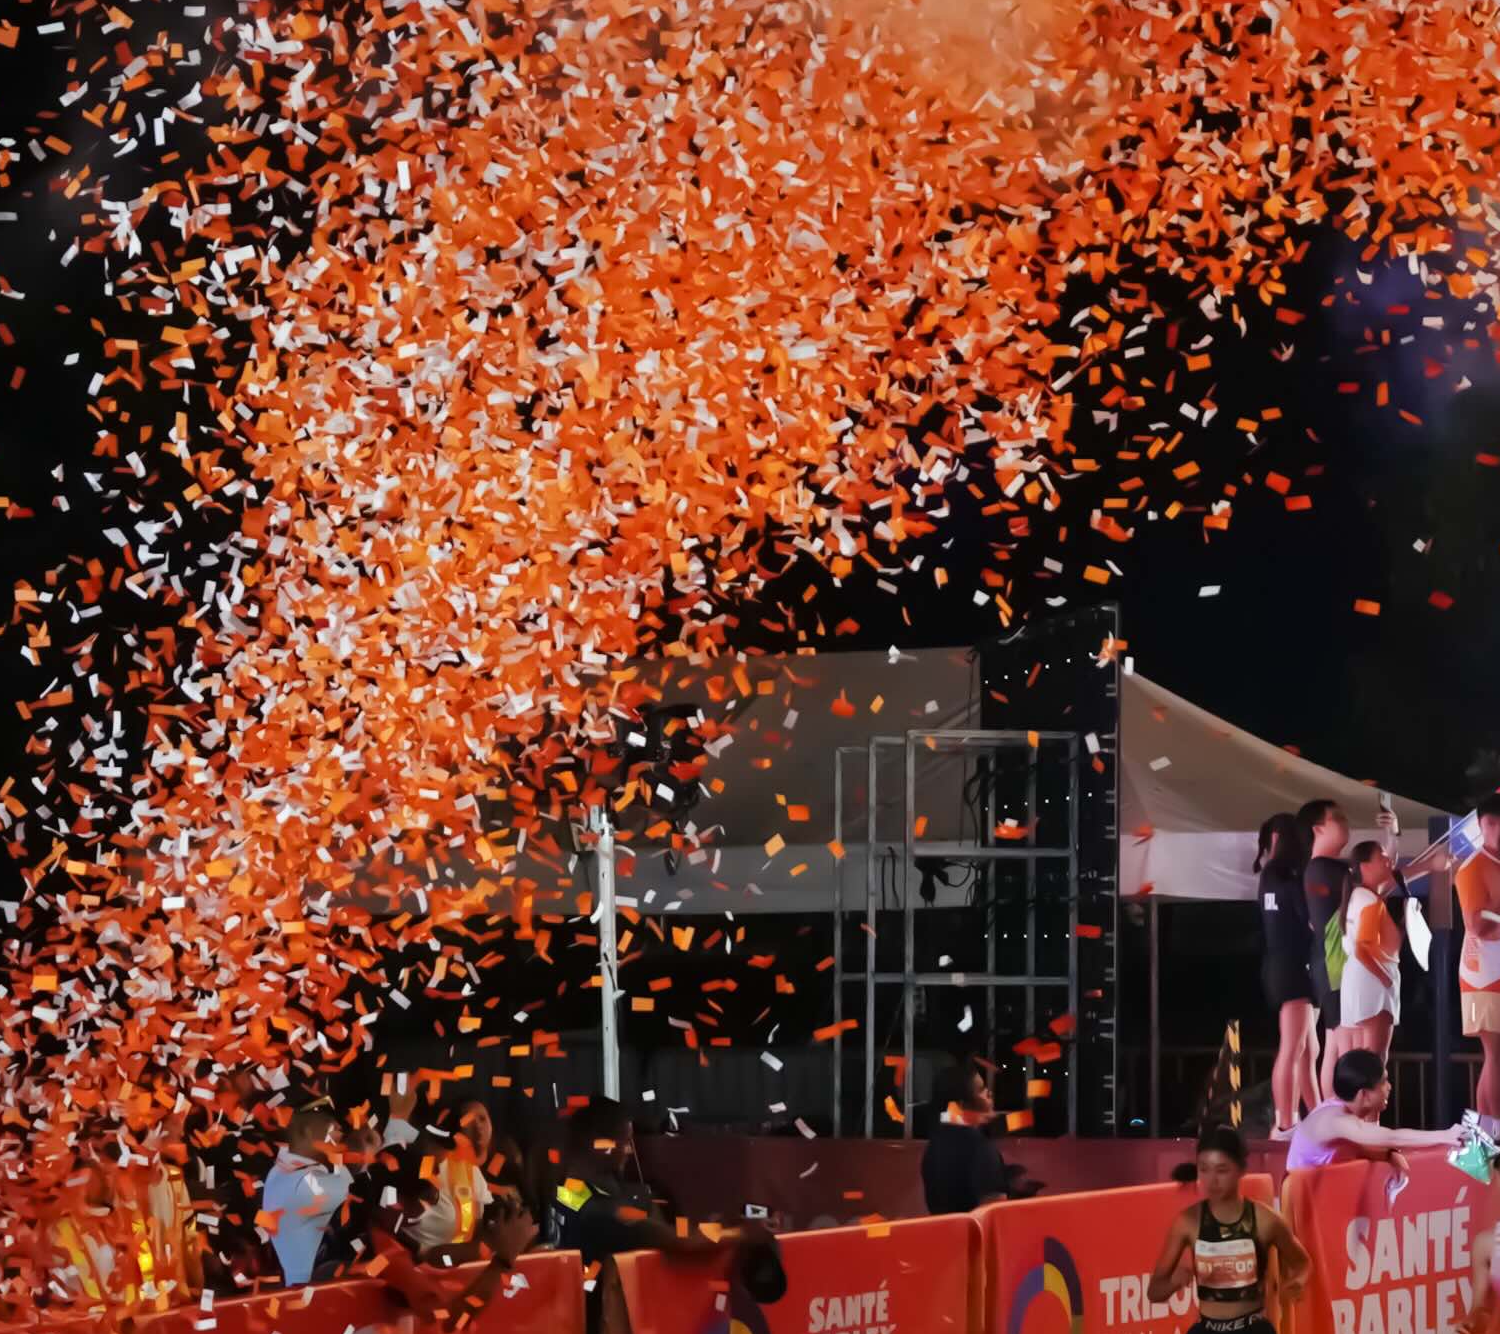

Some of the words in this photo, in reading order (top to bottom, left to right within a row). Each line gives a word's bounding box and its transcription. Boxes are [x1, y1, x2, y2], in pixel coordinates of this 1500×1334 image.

[1346, 1186, 1470, 1290] SANTÉ
[808, 1280, 890, 1333] SANTÉ
[1100, 1272, 1199, 1326] TRIO
[1205, 1318, 1245, 1332] NIKE
